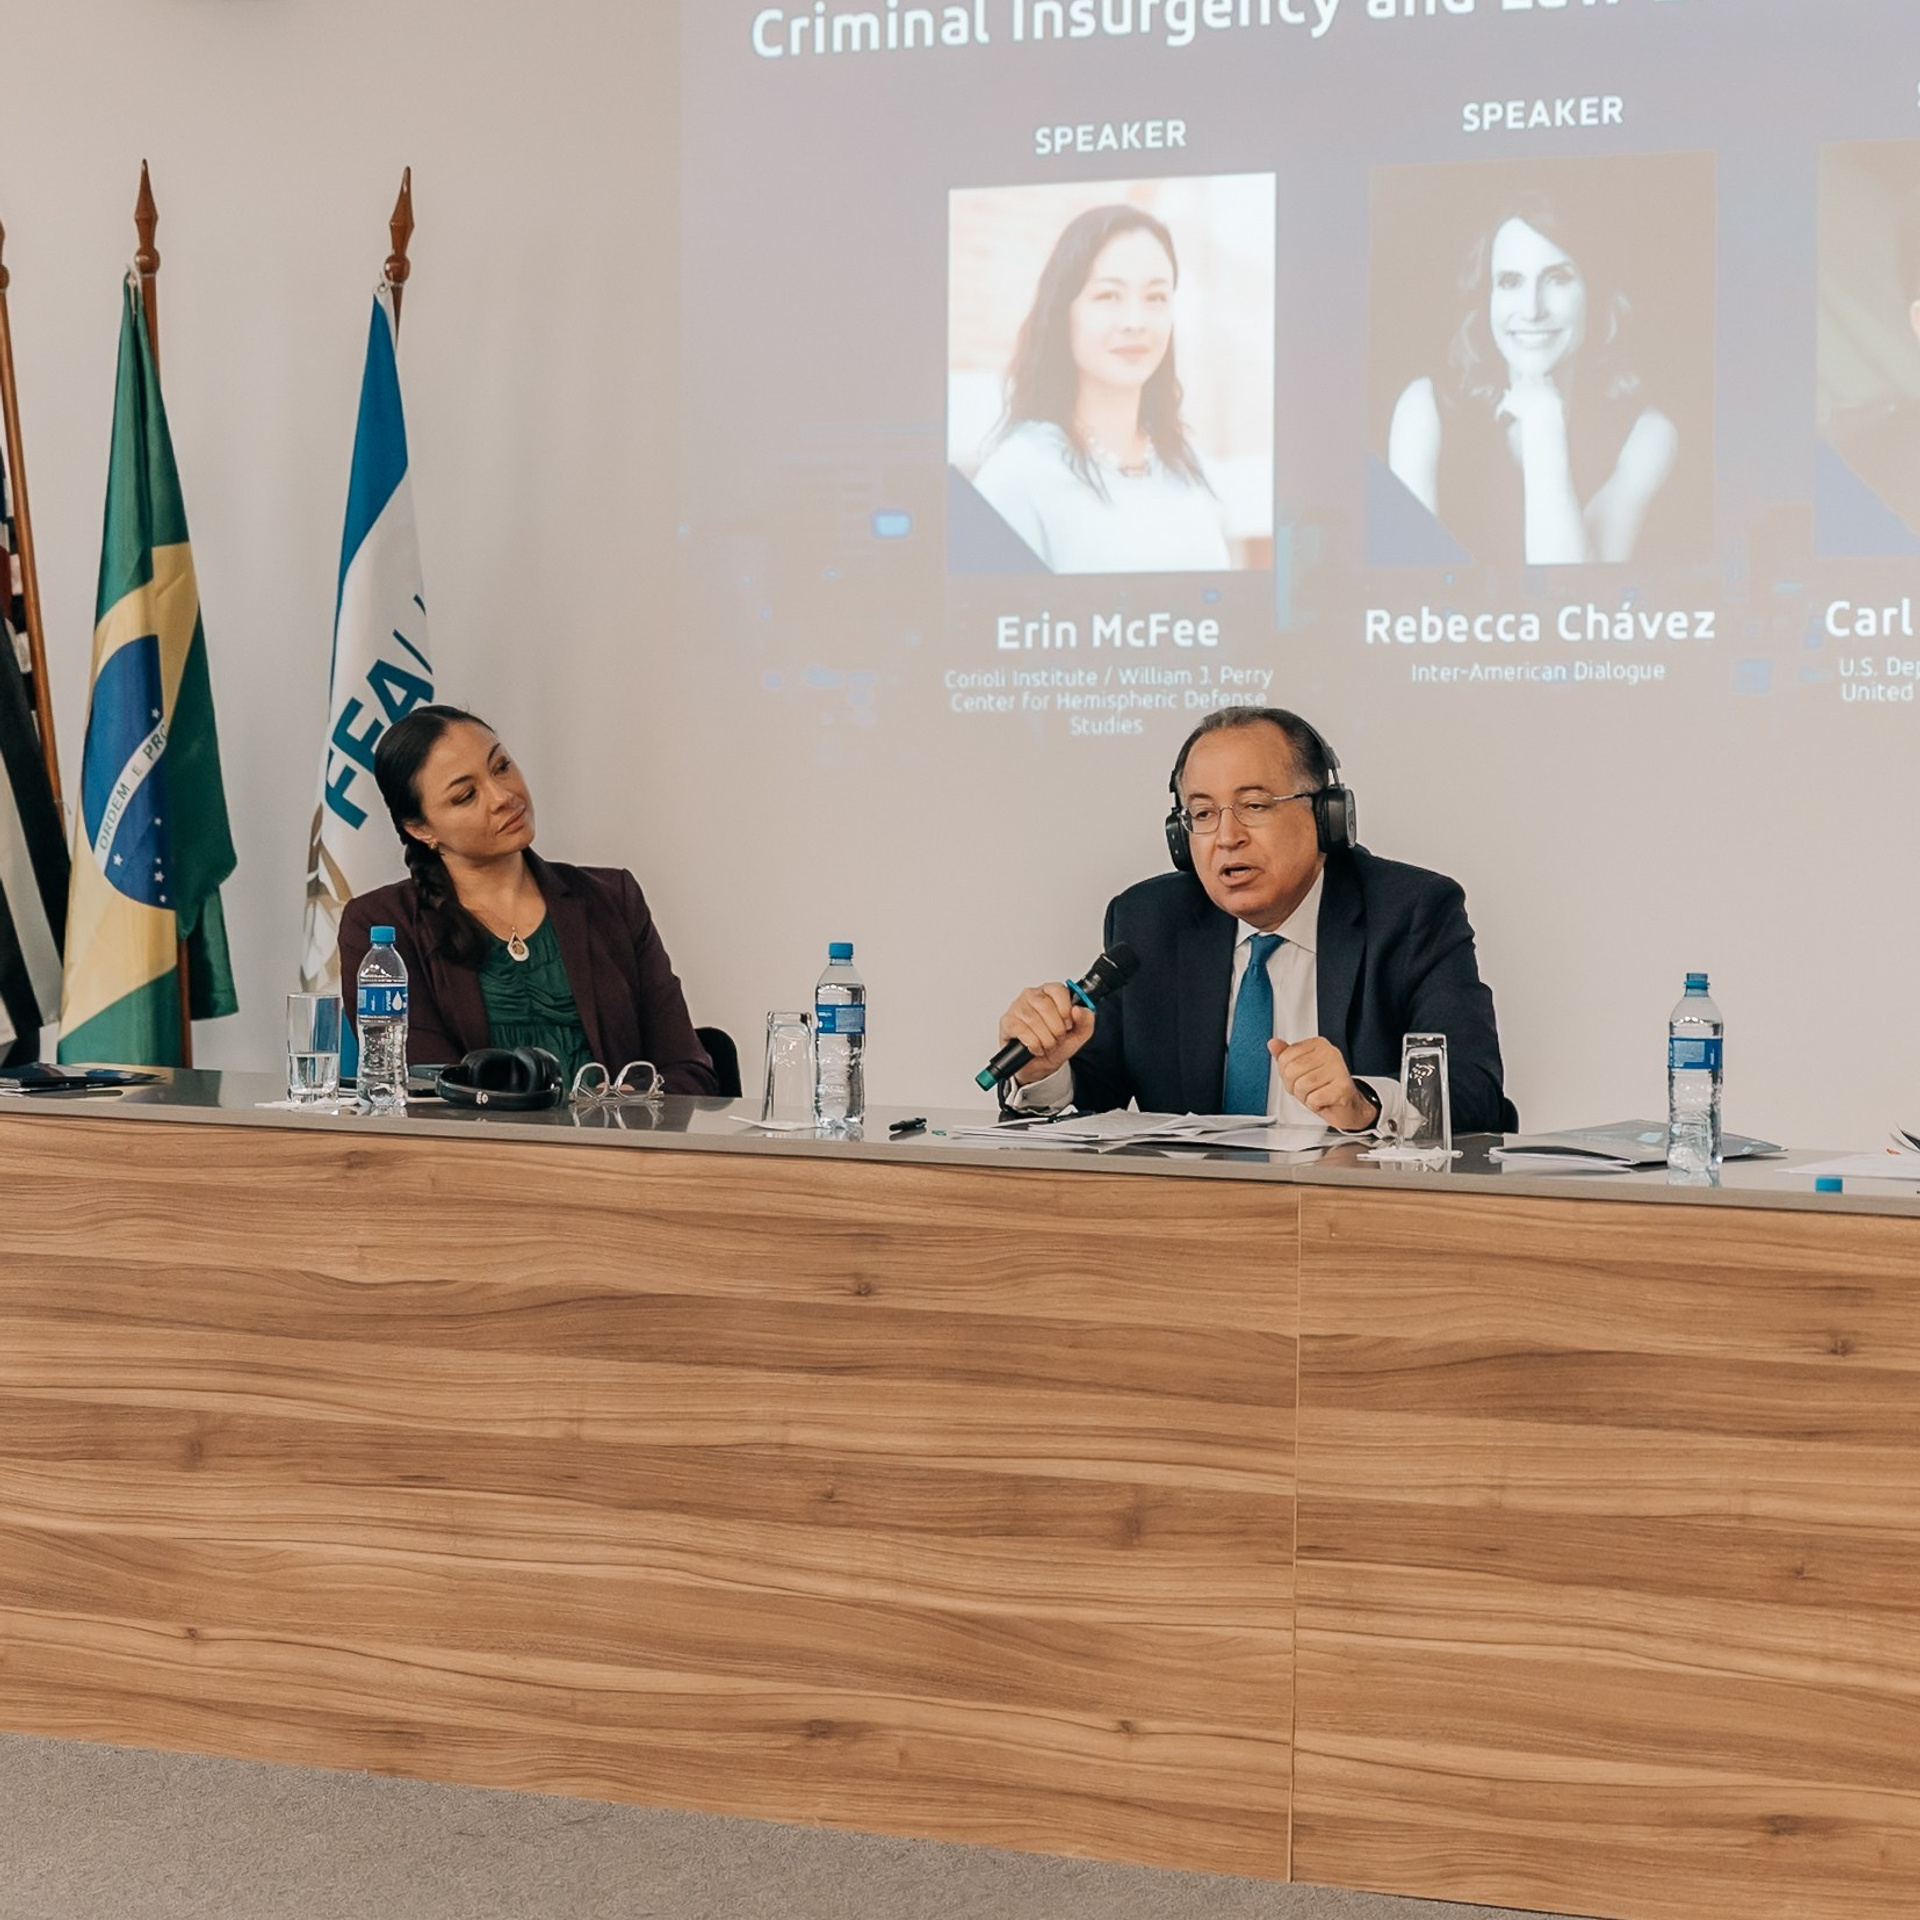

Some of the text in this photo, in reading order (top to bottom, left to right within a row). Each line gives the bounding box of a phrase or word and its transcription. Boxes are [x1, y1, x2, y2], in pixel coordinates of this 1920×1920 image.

[752, 0, 1340, 58] Criminal Insurgency
[1461, 96, 1624, 132] SPEAKER
[1035, 119, 1187, 155] SPEAKER
[996, 612, 1220, 650] Erin McFee
[1365, 602, 1716, 644] Rebecca Chávez
[1825, 597, 1914, 637] Carl
[944, 666, 1274, 689] Corioli Institute / William J. Perry
[1411, 660, 1666, 685] Inter-American Dialogue
[1839, 657, 1879, 676] U.S.
[951, 689, 1268, 713] Center for Hemispheric Defense
[1842, 681, 1914, 703] United
[1071, 716, 1143, 736] Studies
[99, 783, 130, 850] ORDEM
[132, 764, 142, 778] E
